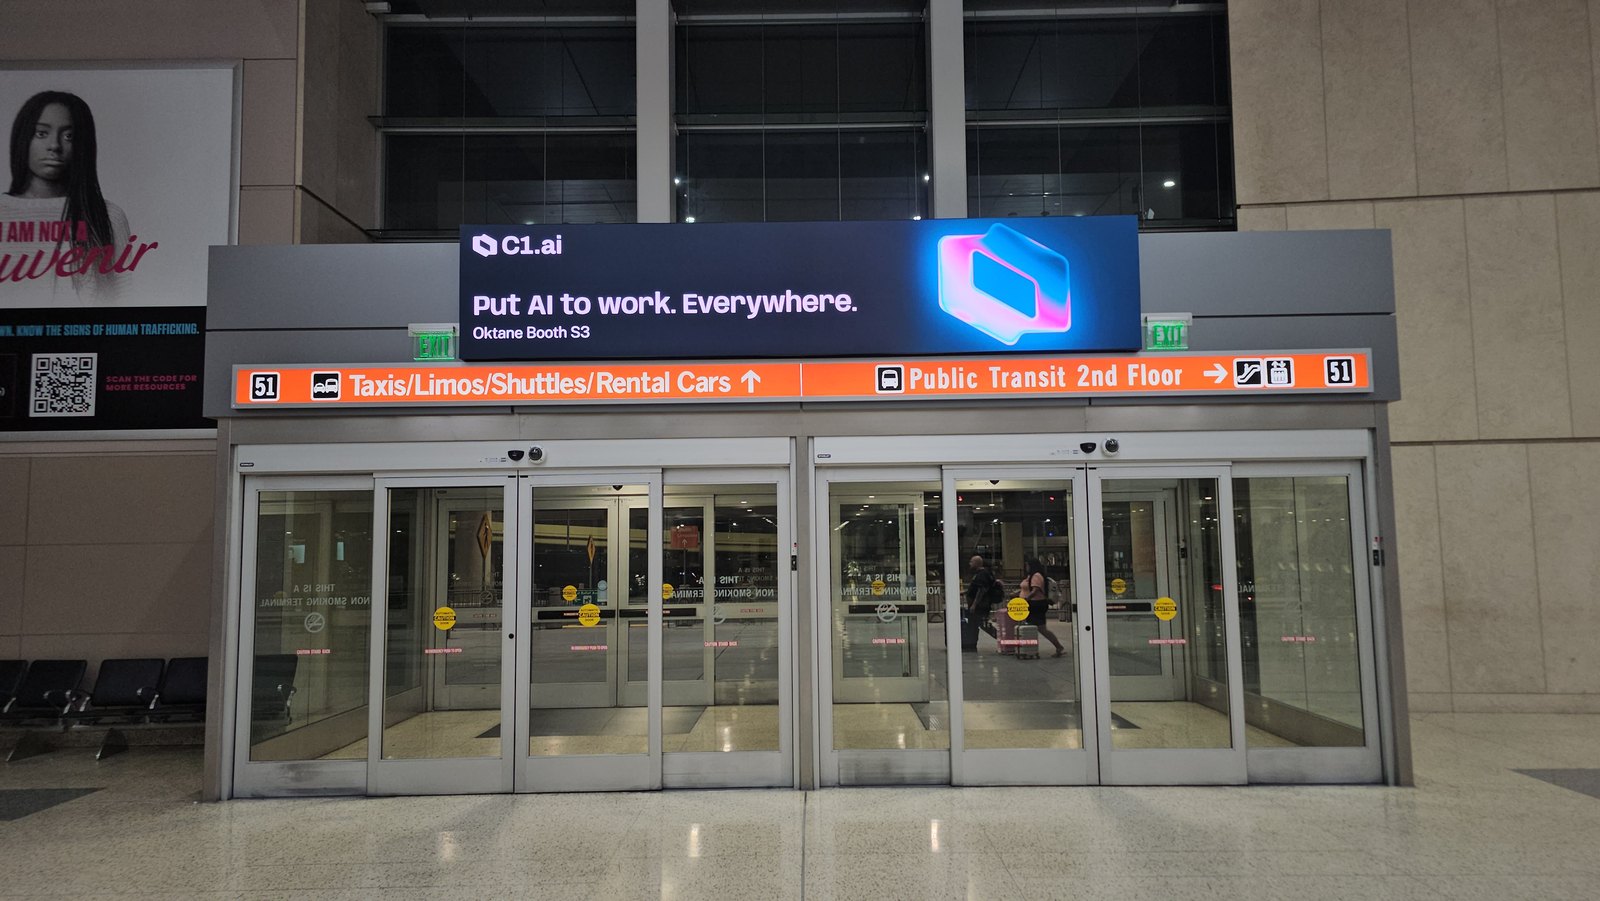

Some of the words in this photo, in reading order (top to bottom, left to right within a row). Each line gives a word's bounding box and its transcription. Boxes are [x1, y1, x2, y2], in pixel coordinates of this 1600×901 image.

[7, 221, 34, 242] AM
[39, 220, 71, 242] NOT
[76, 220, 88, 241] A
[501, 234, 562, 255] C1.ai
[473, 293, 521, 316] Put
[527, 294, 553, 316] AI
[559, 293, 592, 315] to
[597, 291, 677, 315] work.
[682, 289, 858, 320] Everywhere.
[16, 325, 43, 337] KNOW
[46, 325, 62, 337] THE
[64, 324, 91, 336] SIGNS
[93, 324, 104, 336] OF
[105, 324, 138, 336] HUMAN
[140, 323, 200, 335] TRAFFICKING.
[472, 327, 523, 340] Oktane
[526, 326, 568, 339] Booth
[570, 325, 591, 339] S3
[1153, 323, 1184, 347] EXIT
[420, 335, 449, 357] EXIT
[106, 375, 132, 383] SCAN
[134, 375, 150, 383] THE
[153, 374, 177, 382] CODE
[179, 374, 197, 382] FOR
[677, 371, 731, 393] Cars
[910, 367, 978, 390] Public
[989, 365, 1066, 388] Transit
[1077, 364, 1117, 387] 2nd
[1127, 363, 1183, 386] Floor
[1330, 361, 1350, 382] 51
[134, 383, 186, 391] RESOURCES
[255, 377, 275, 396] 51
